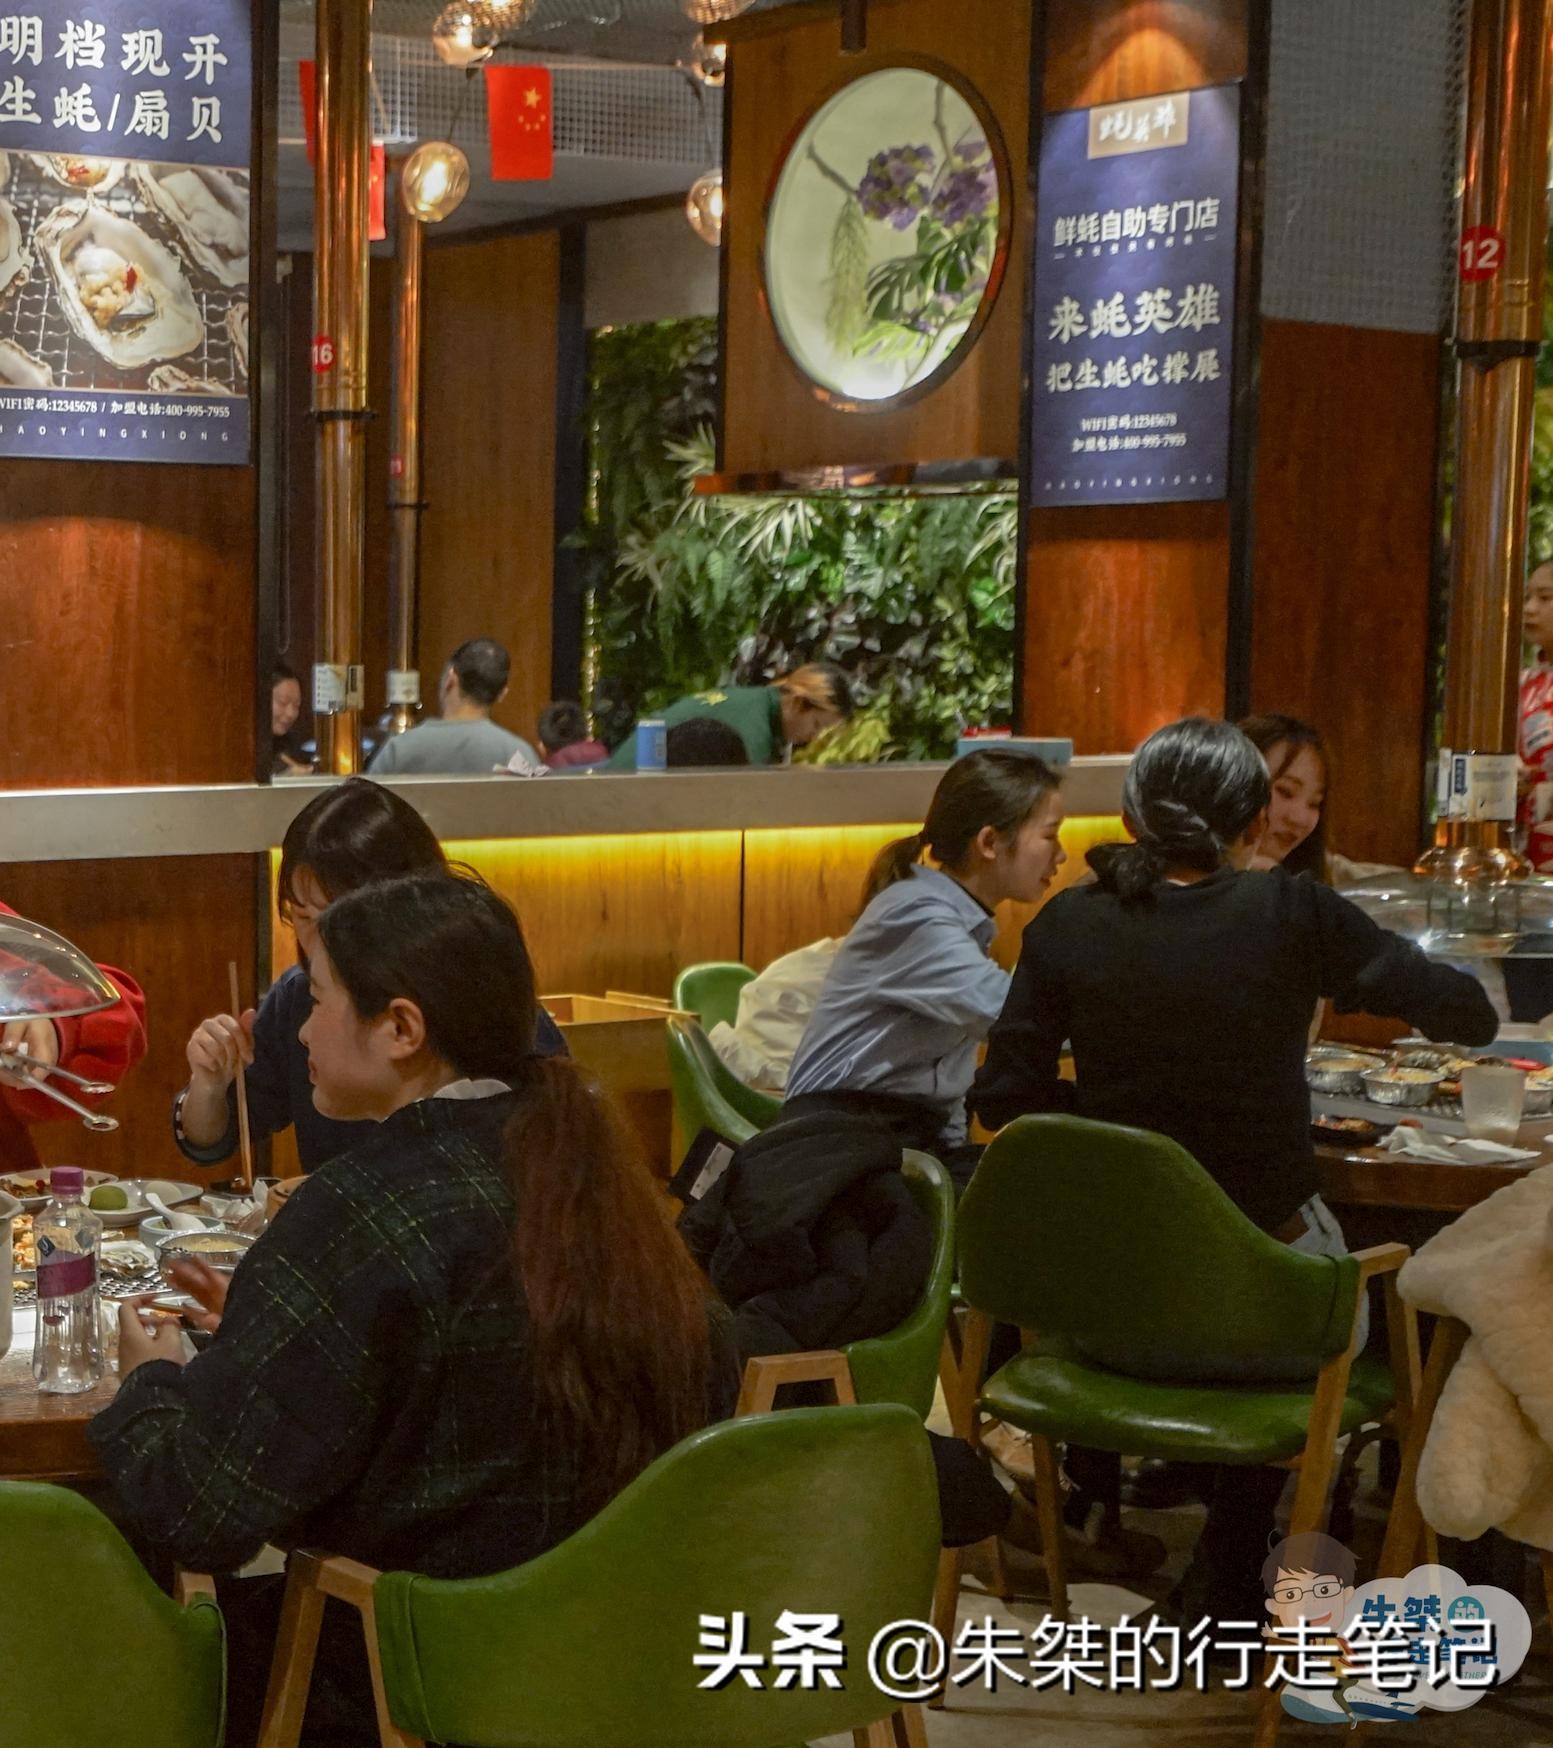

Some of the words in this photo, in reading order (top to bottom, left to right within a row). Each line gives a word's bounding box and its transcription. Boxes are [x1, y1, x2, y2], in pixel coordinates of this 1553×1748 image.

[1053, 197, 1221, 248] 鲜蚝自助专门店
[1462, 238, 1500, 270] 12
[1048, 283, 1222, 344] 来蚝英雄
[312, 343, 334, 365] 16
